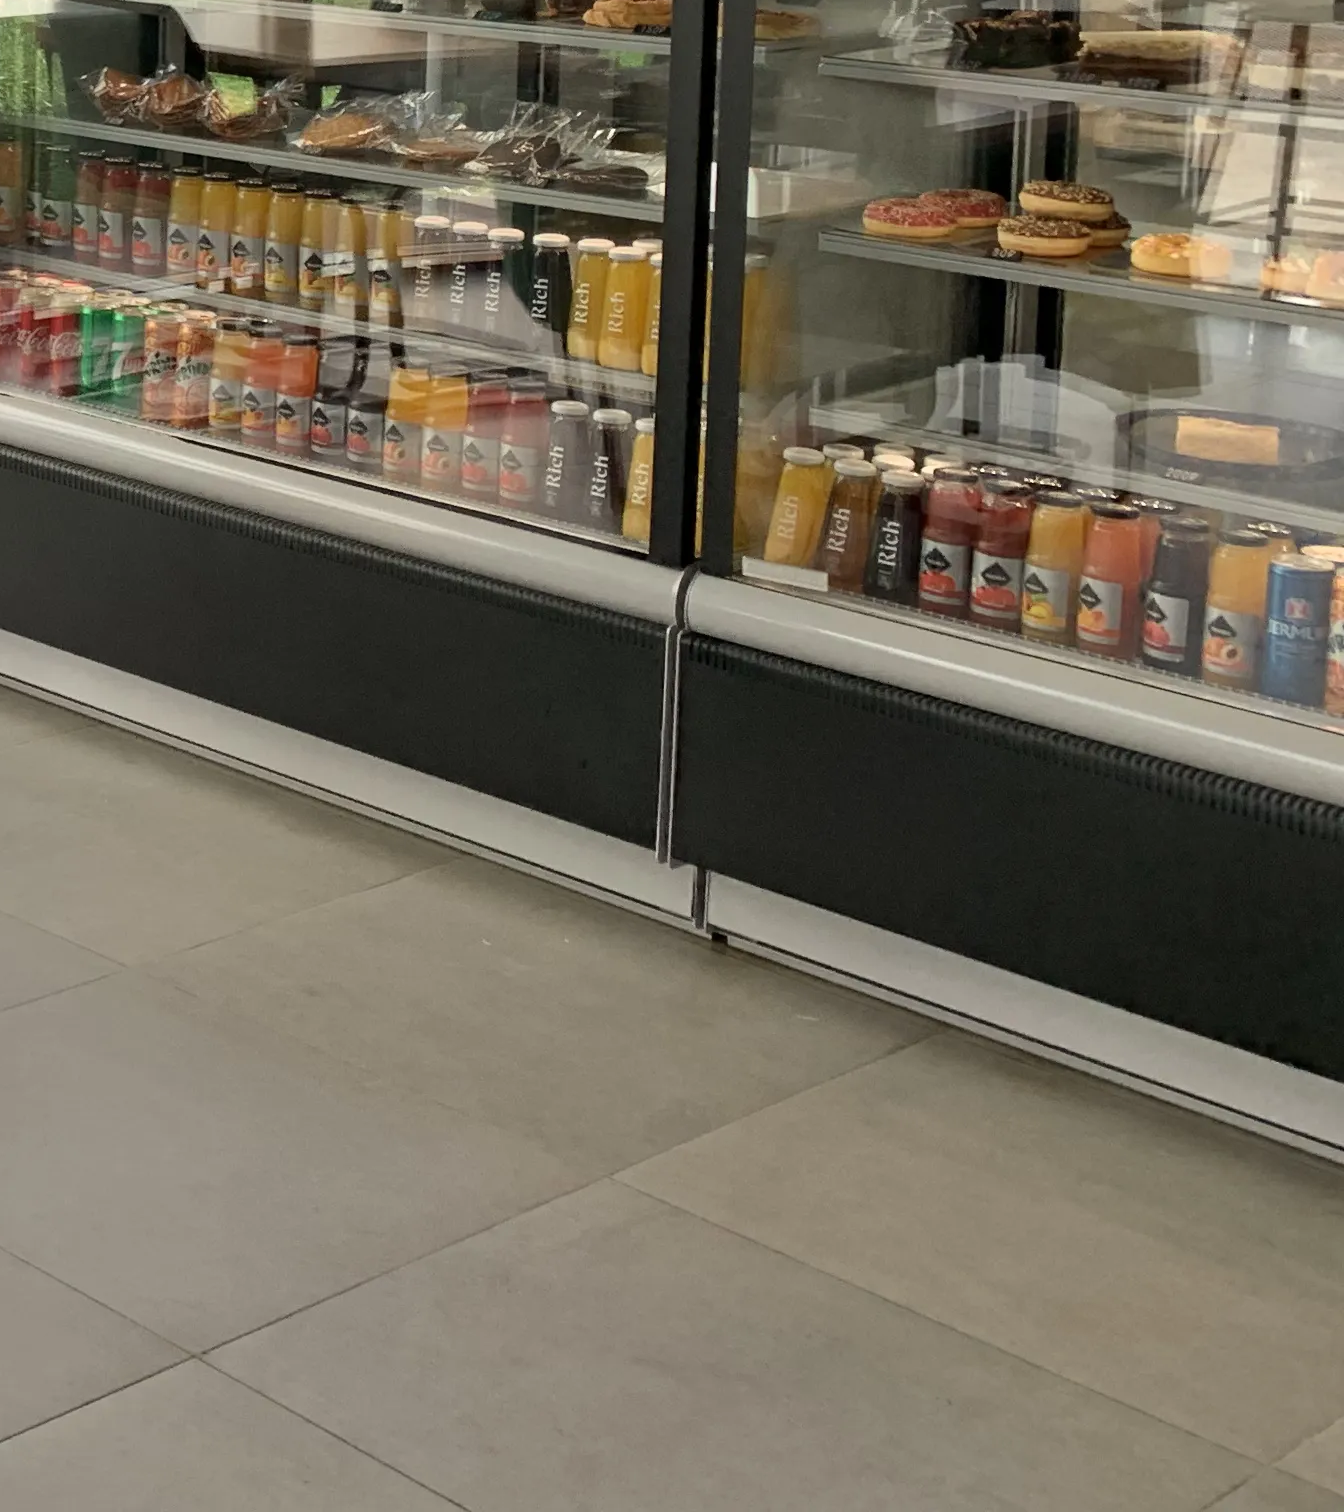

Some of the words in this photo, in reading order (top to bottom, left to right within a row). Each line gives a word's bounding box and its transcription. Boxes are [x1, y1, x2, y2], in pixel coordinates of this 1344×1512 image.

[450, 264, 466, 305] Rich
[484, 271, 501, 313] Rich
[531, 277, 549, 320] Rich
[574, 282, 590, 324] Rich
[608, 290, 625, 333] Rich
[545, 445, 564, 488] Rich
[590, 455, 609, 499] Rich
[631, 463, 649, 506] Rich
[777, 495, 799, 539] Rich
[826, 507, 851, 553] Rich
[877, 519, 901, 566] Rich
